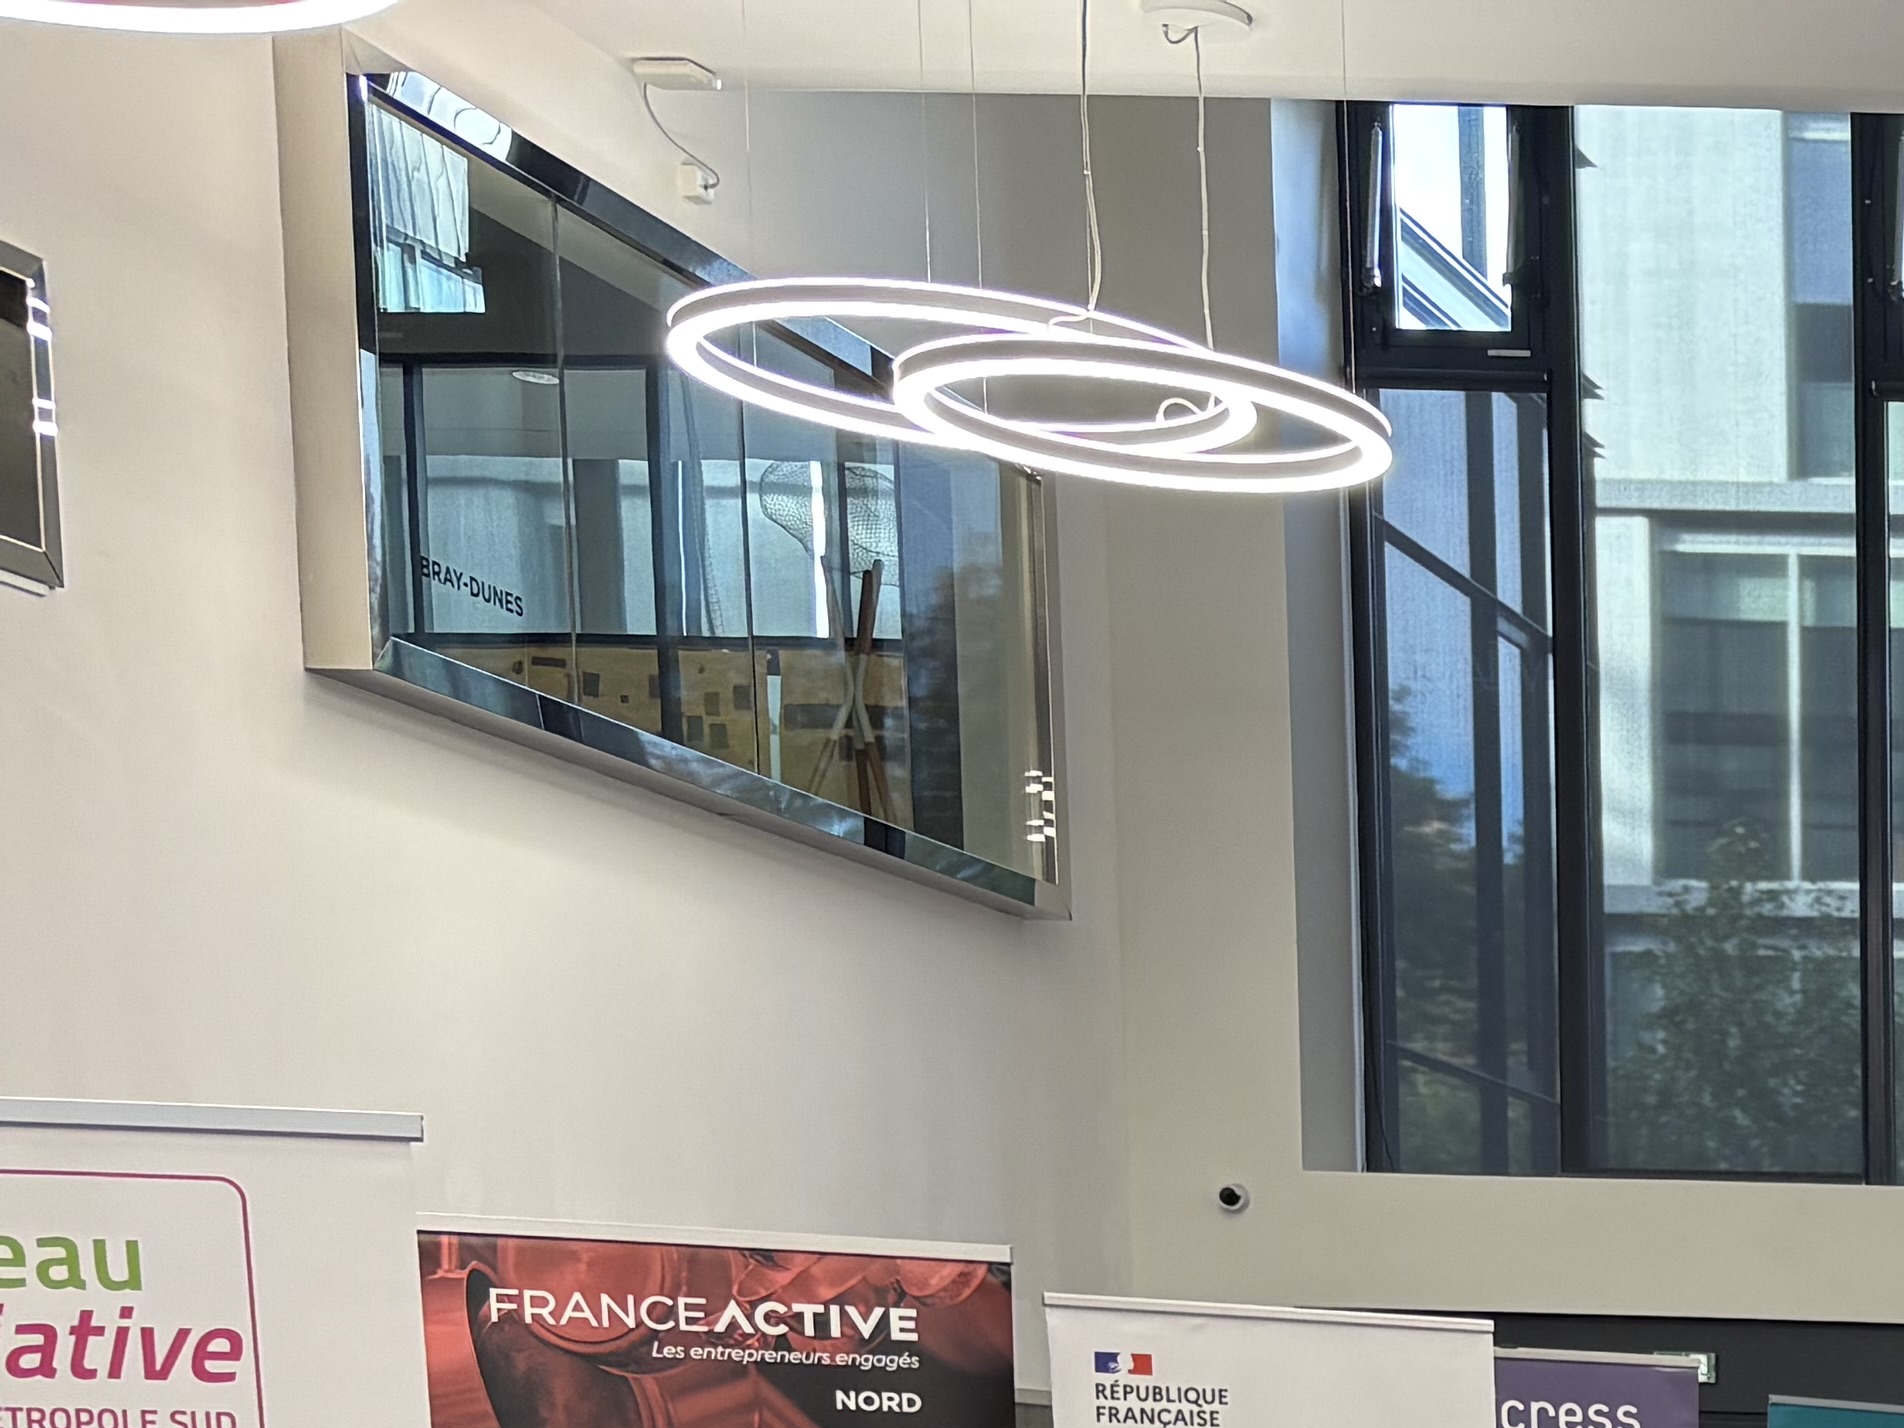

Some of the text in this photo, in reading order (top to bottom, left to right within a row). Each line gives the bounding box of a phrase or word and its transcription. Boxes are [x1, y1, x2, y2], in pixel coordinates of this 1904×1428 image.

[420, 554, 524, 617] BRAY-DUNES
[0, 1303, 243, 1384] ative
[652, 1341, 919, 1371] Les entrepreneurs engagés
[835, 1389, 922, 1413] NORD
[1095, 1380, 1229, 1408] RÉPUBLIQUE
[1096, 1405, 1220, 1428] FRANÇAISE
